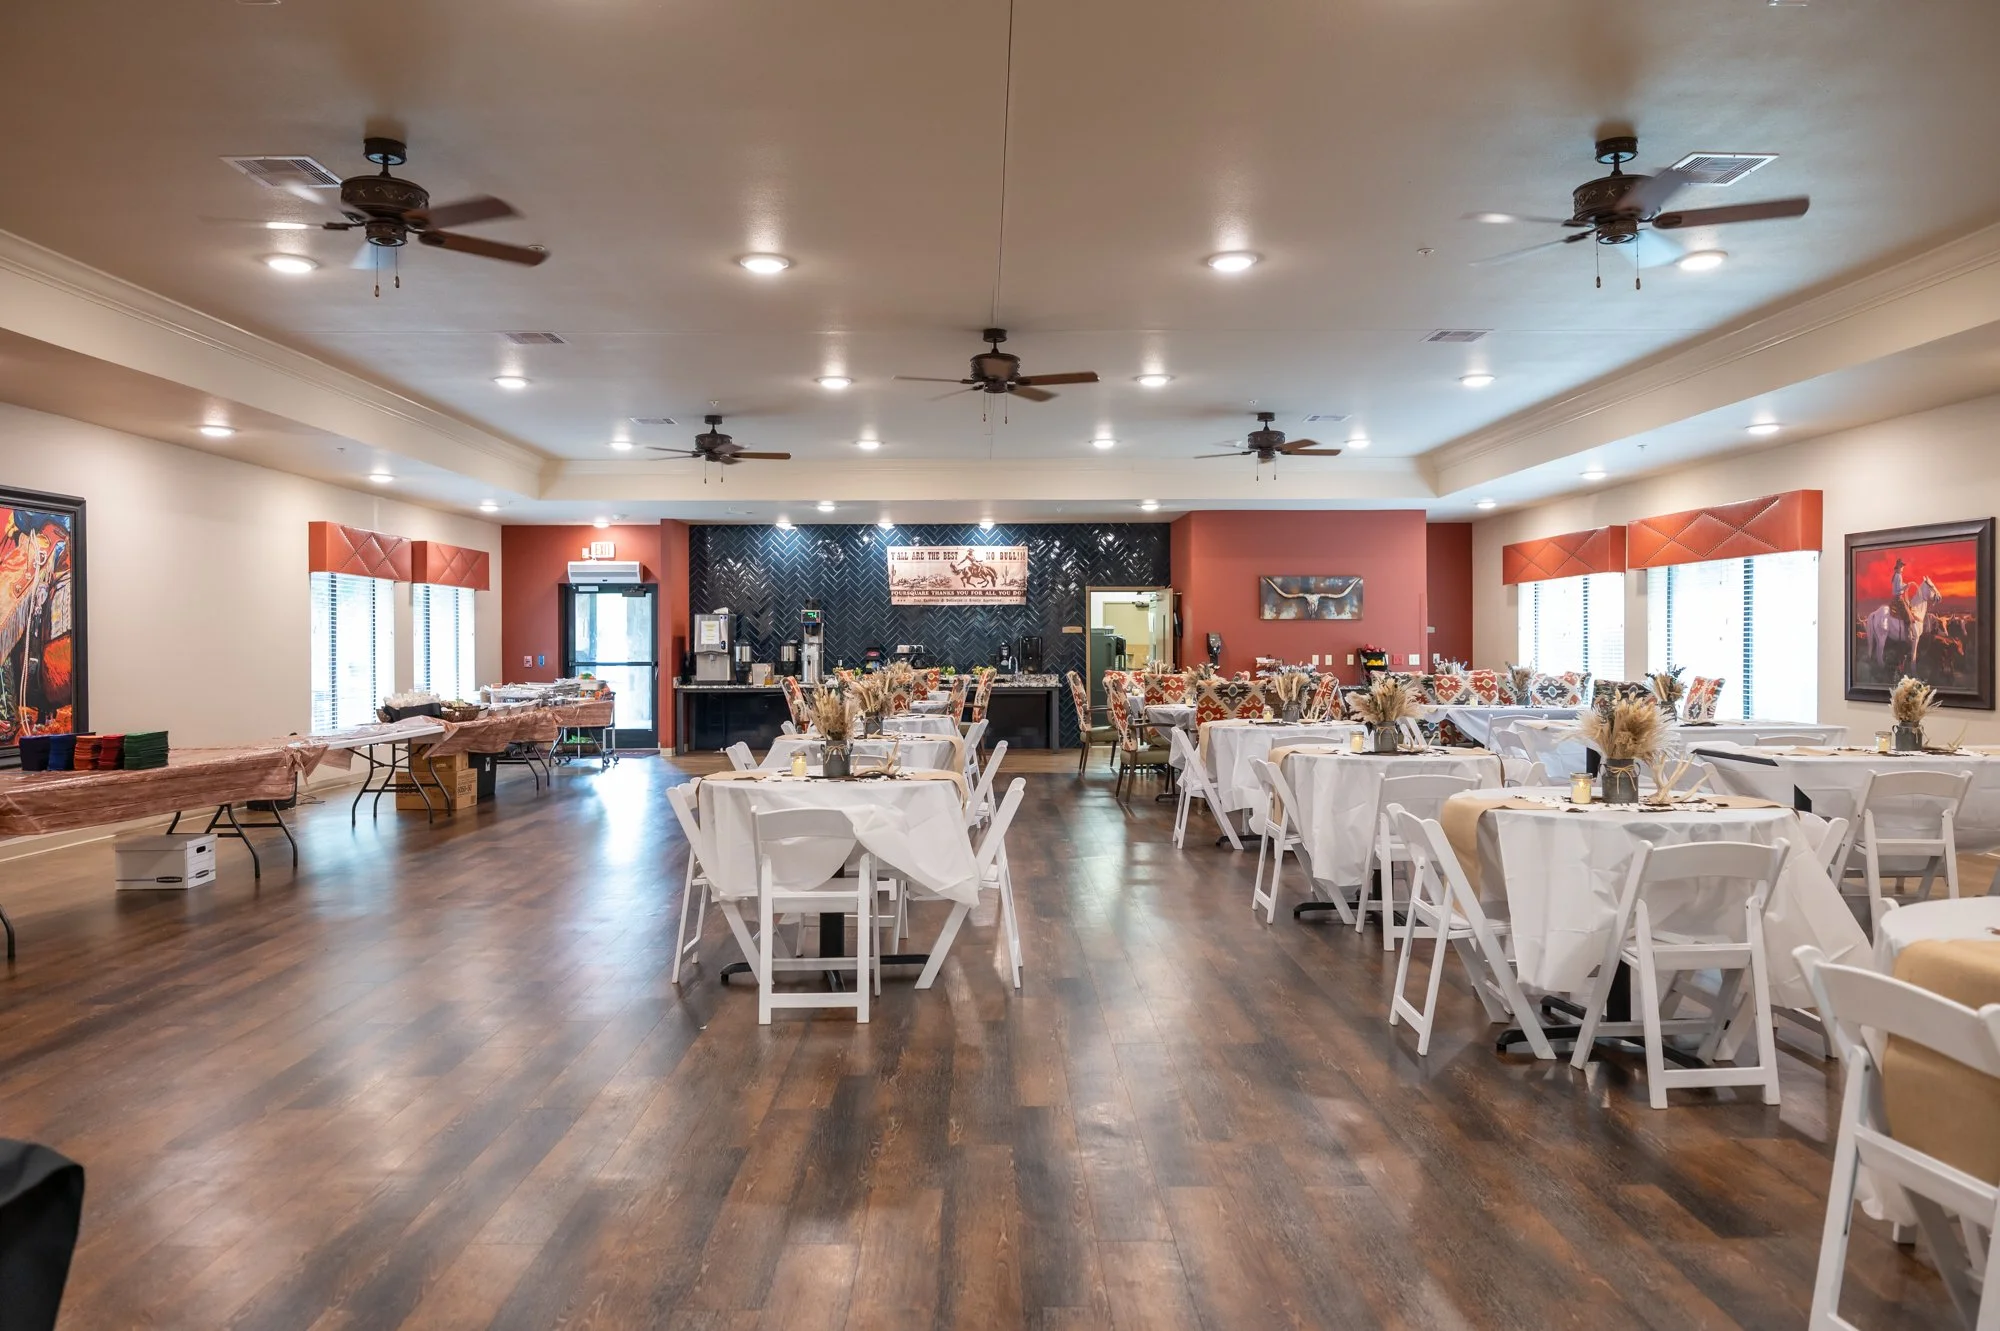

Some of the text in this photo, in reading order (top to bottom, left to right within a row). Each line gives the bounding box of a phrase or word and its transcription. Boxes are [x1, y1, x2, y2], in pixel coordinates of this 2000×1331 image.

[595, 544, 610, 555] EXIT
[912, 552, 924, 560] ARE
[928, 552, 939, 560] THE
[943, 552, 958, 560] BEST
[986, 552, 995, 560] NO
